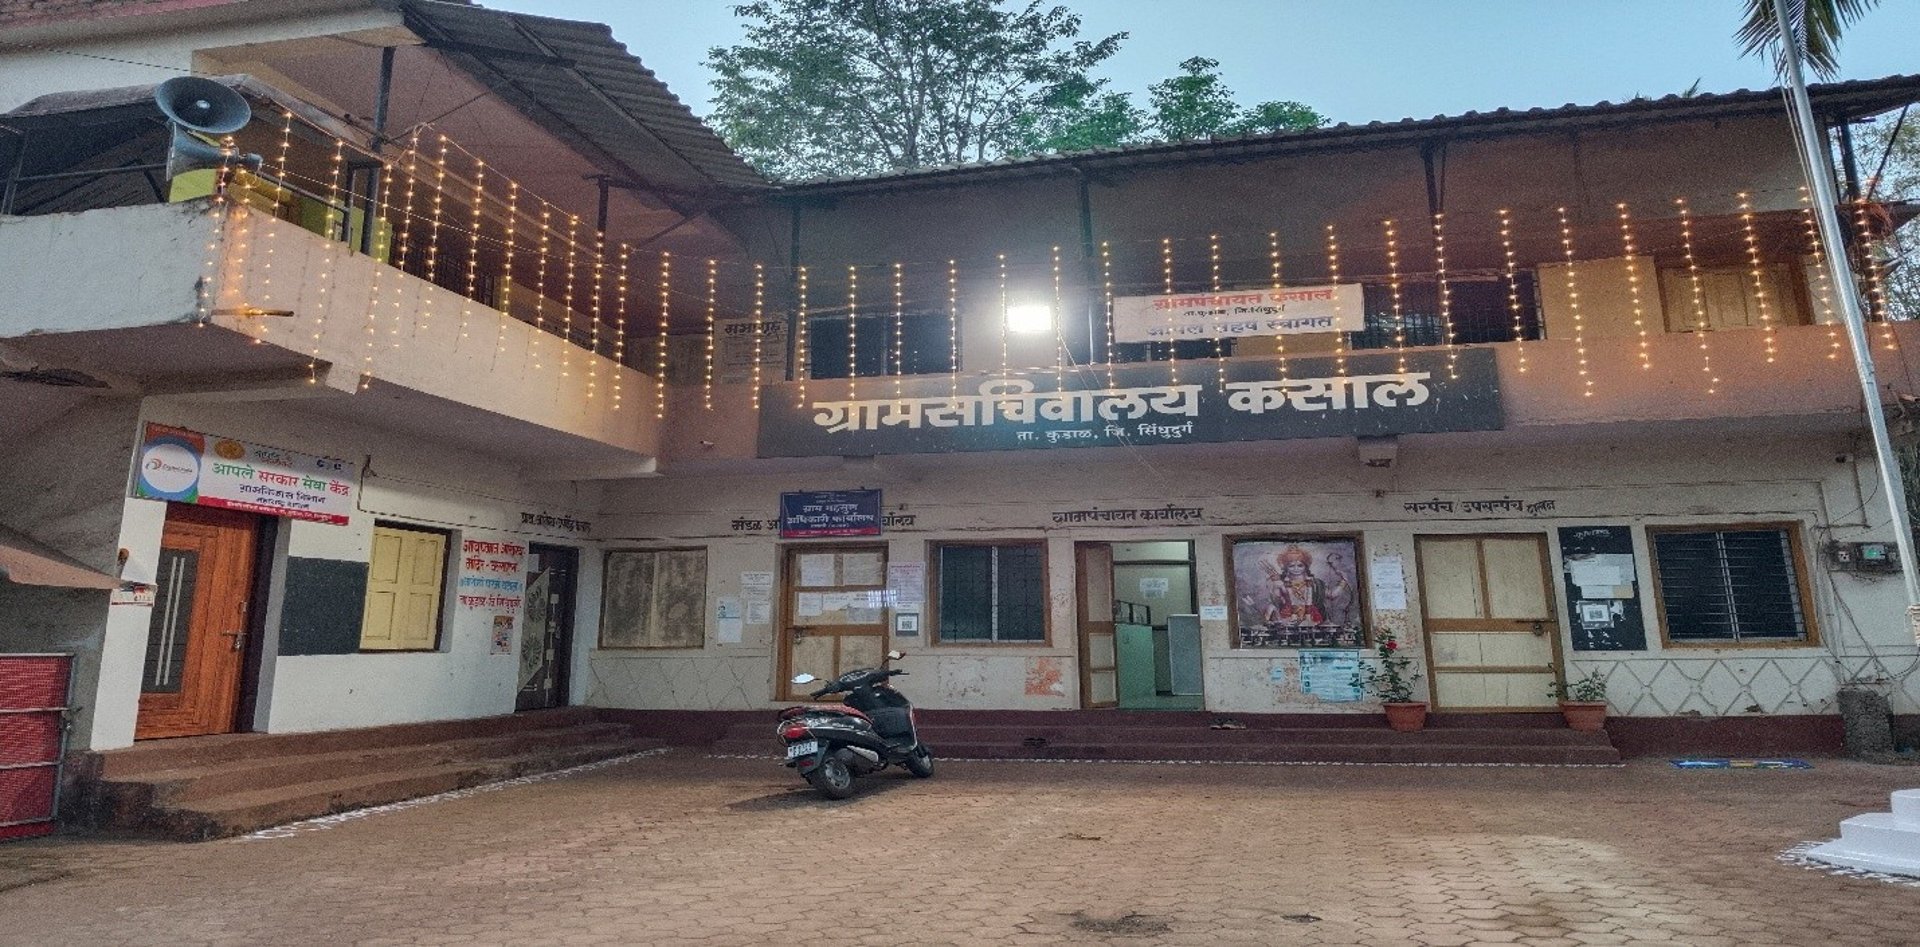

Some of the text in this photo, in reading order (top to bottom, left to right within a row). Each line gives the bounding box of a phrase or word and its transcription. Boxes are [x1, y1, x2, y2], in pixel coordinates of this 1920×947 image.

[813, 372, 1431, 433] ग्रामसचिवालय कसाल
[1016, 420, 1194, 443] ता. कुडाळ, जि. सिंधुदुर्ग
[211, 460, 350, 497] आपले सरकार सेवा केंद्र
[1052, 504, 1204, 523] ग्रामपंचायत कार्यालय
